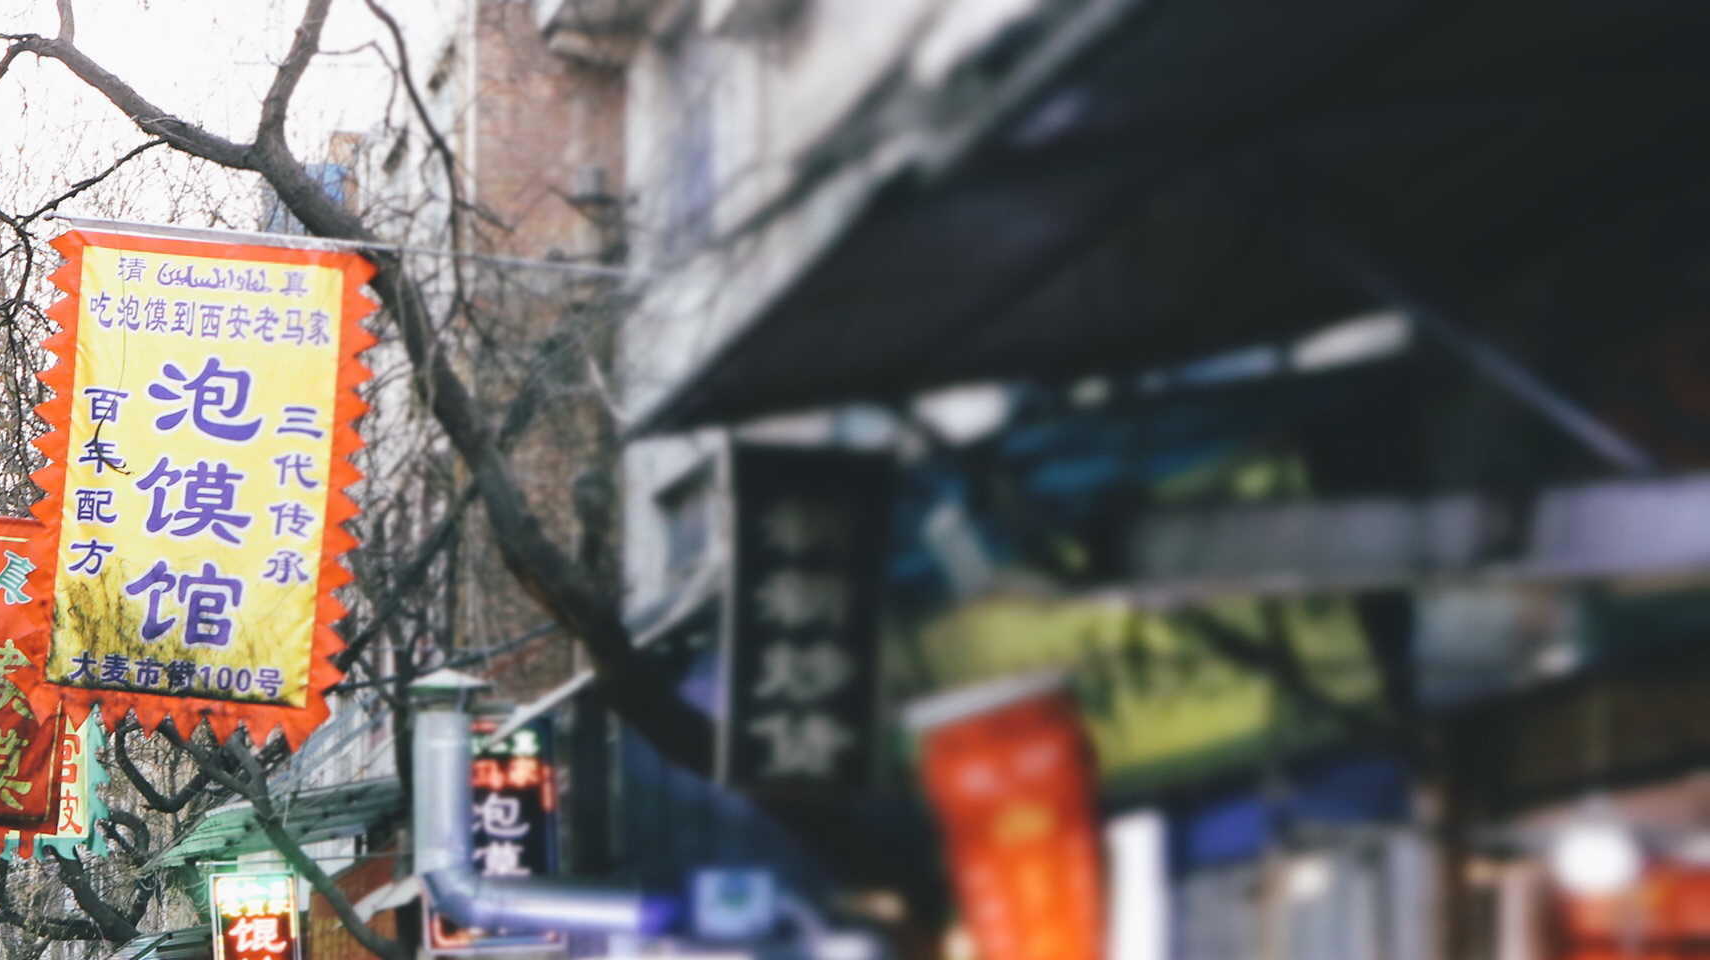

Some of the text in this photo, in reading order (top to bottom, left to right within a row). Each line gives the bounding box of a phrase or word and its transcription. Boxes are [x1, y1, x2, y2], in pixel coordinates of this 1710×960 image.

[89, 291, 331, 346] 吃泡馍到西安老马家
[117, 256, 309, 298] 清 真
[66, 388, 129, 576] 百年配方
[124, 356, 266, 648] 泡馍馆
[262, 405, 325, 586] 三代传承
[69, 651, 285, 699] 大麦市街100号
